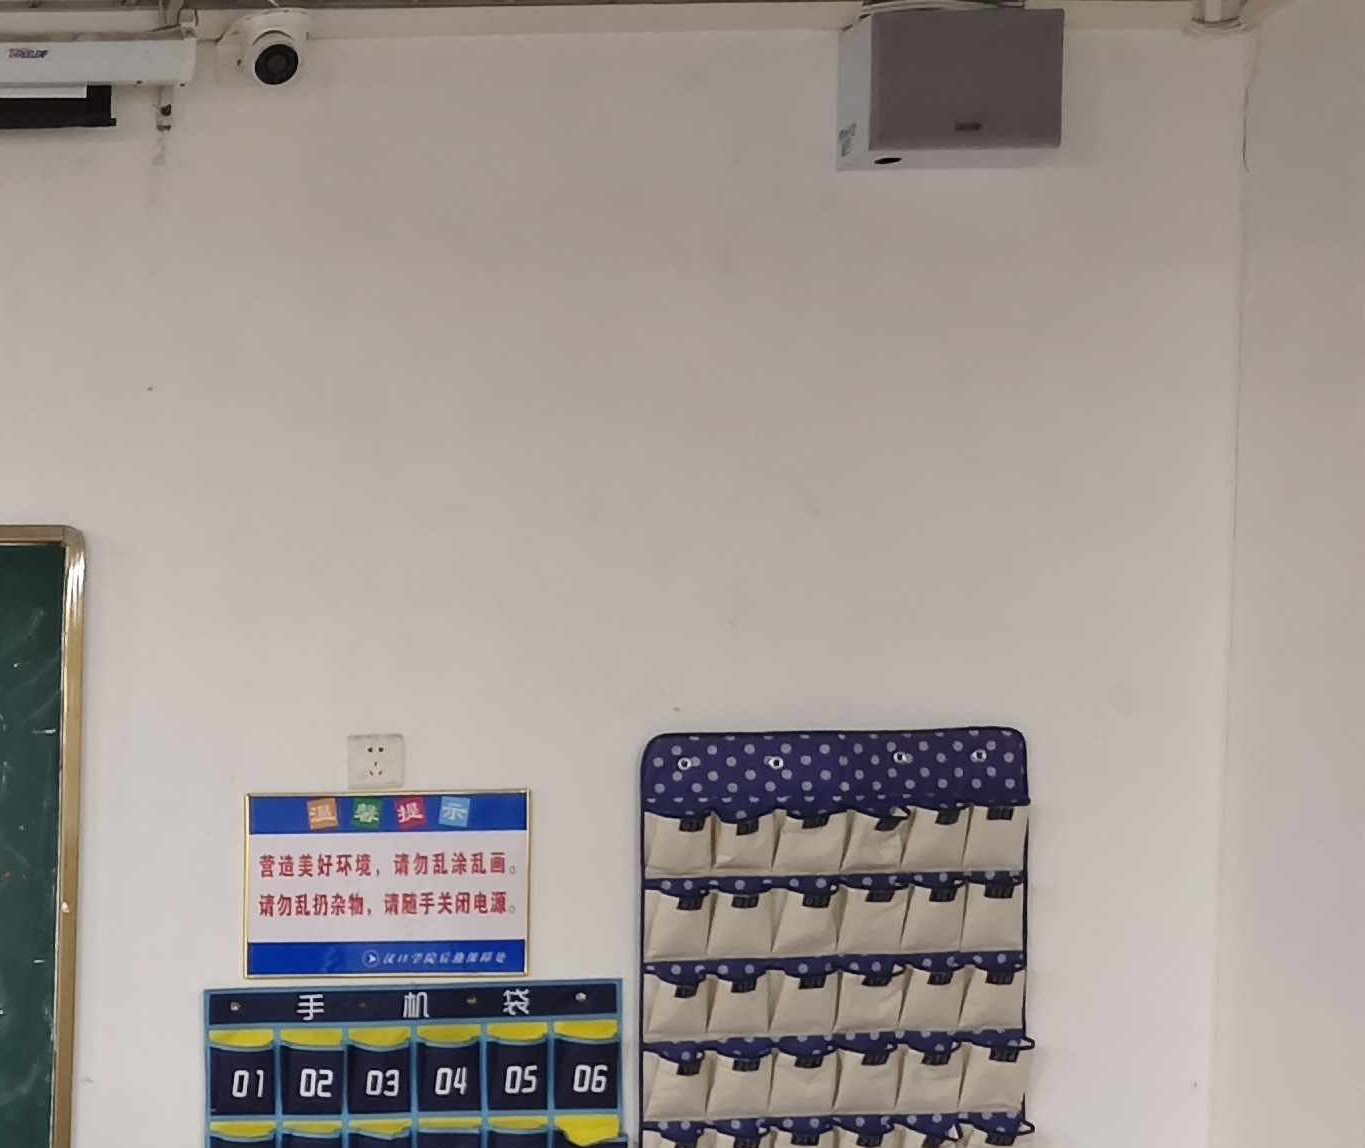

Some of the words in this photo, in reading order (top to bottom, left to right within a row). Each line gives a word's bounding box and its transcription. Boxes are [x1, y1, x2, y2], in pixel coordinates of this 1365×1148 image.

[309, 801, 467, 824] 温馨提示
[231, 1069, 264, 1098] 01
[299, 1068, 334, 1098] 02
[365, 1069, 400, 1097] 03
[434, 1066, 467, 1096] 04
[504, 1064, 538, 1094] 05
[572, 1064, 608, 1093] 06
